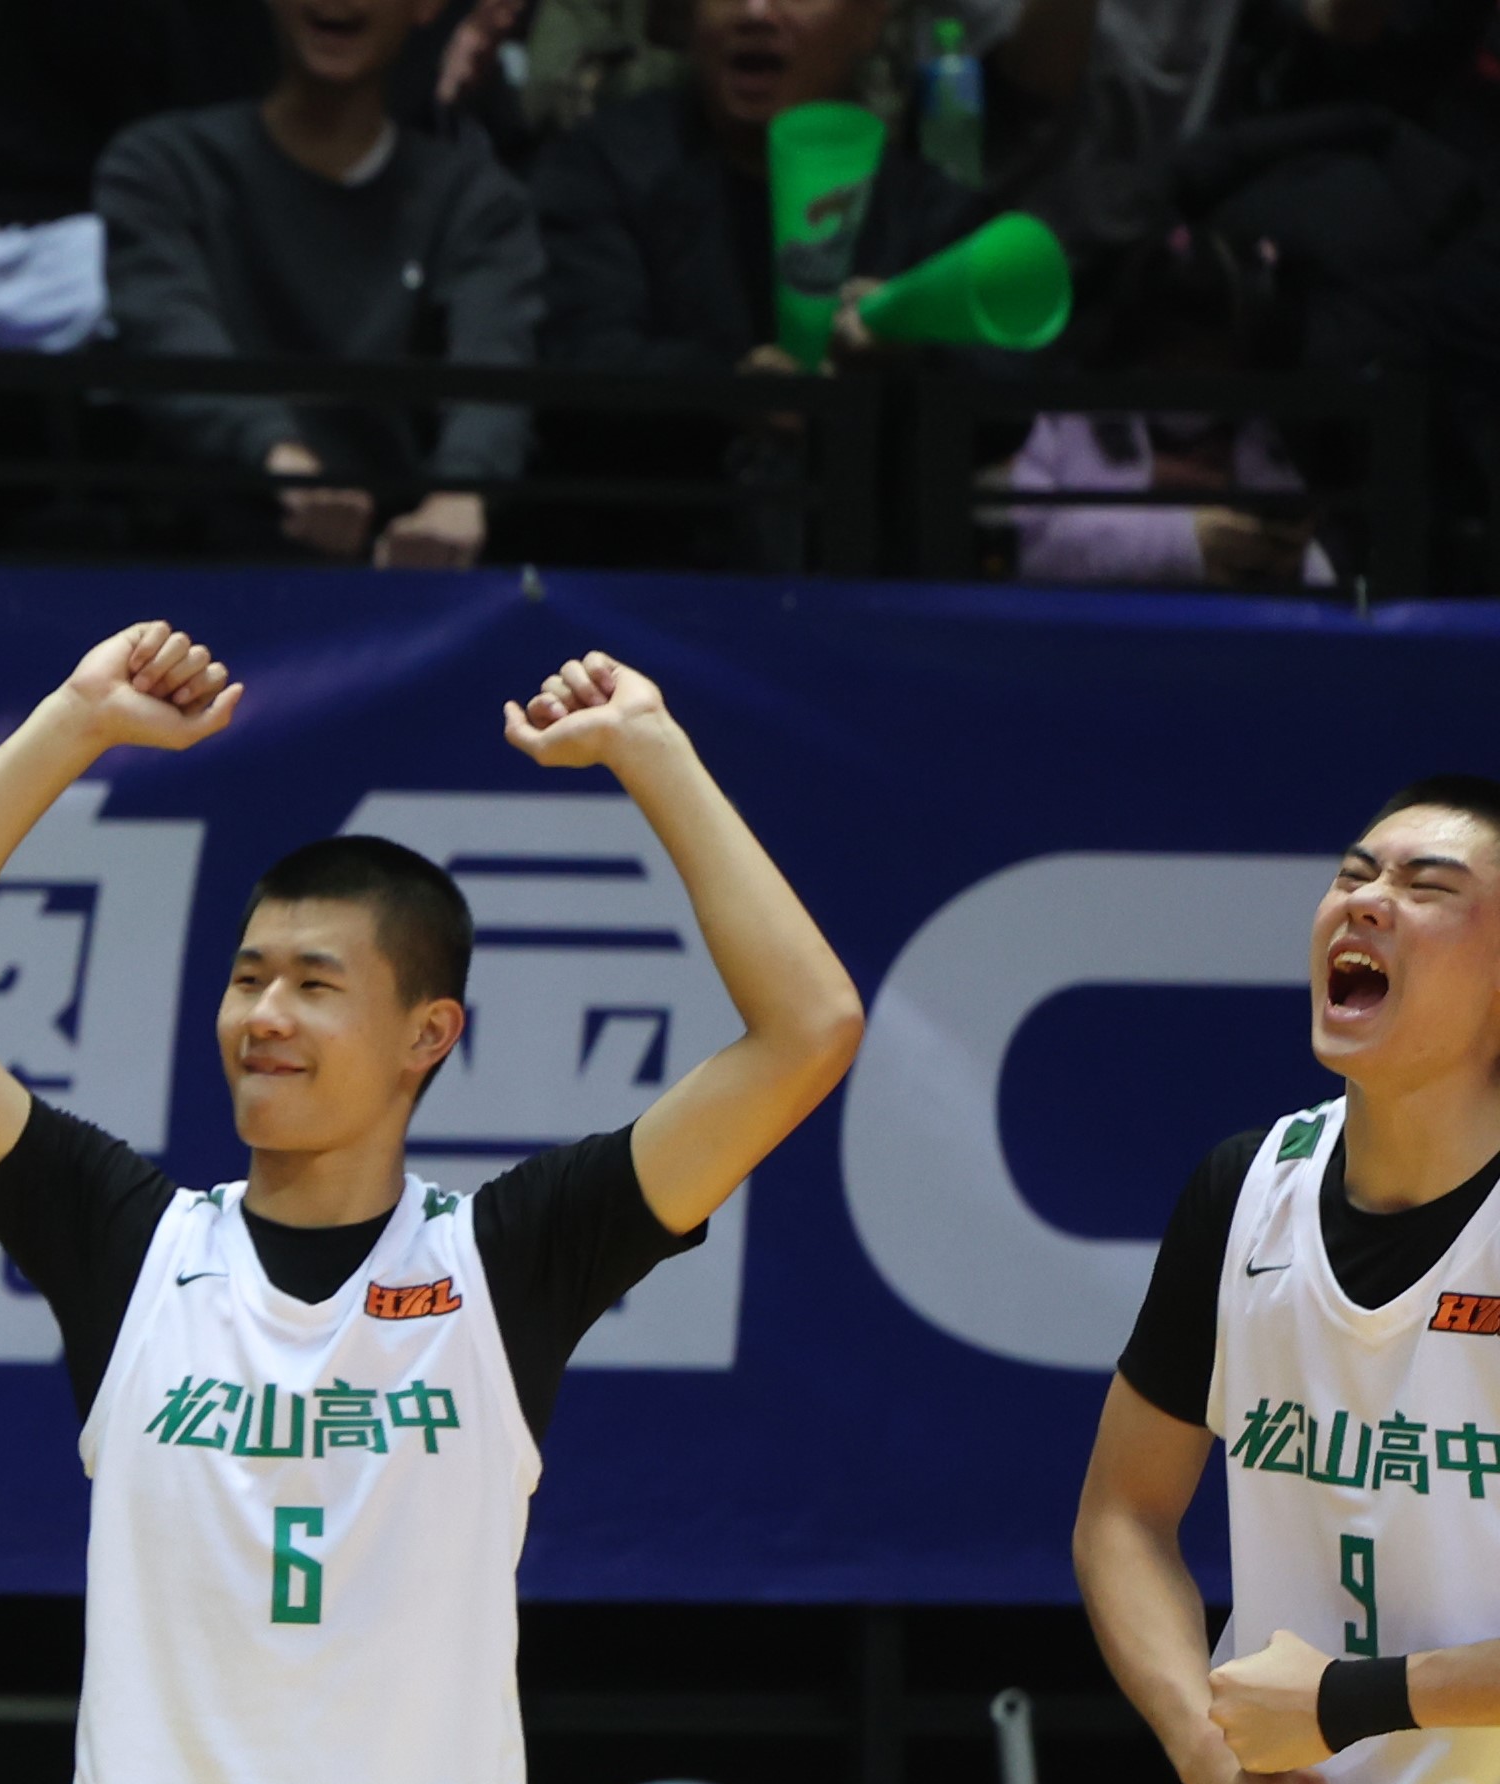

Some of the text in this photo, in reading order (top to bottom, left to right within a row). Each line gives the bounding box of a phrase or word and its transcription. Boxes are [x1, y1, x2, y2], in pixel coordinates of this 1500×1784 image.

[1430, 1292, 1500, 1335] HB
[144, 1375, 460, 1459] 松山高中
[1229, 1397, 1500, 1500] 松山高中
[271, 1506, 324, 1625] 6
[1340, 1534, 1378, 1659] 9
